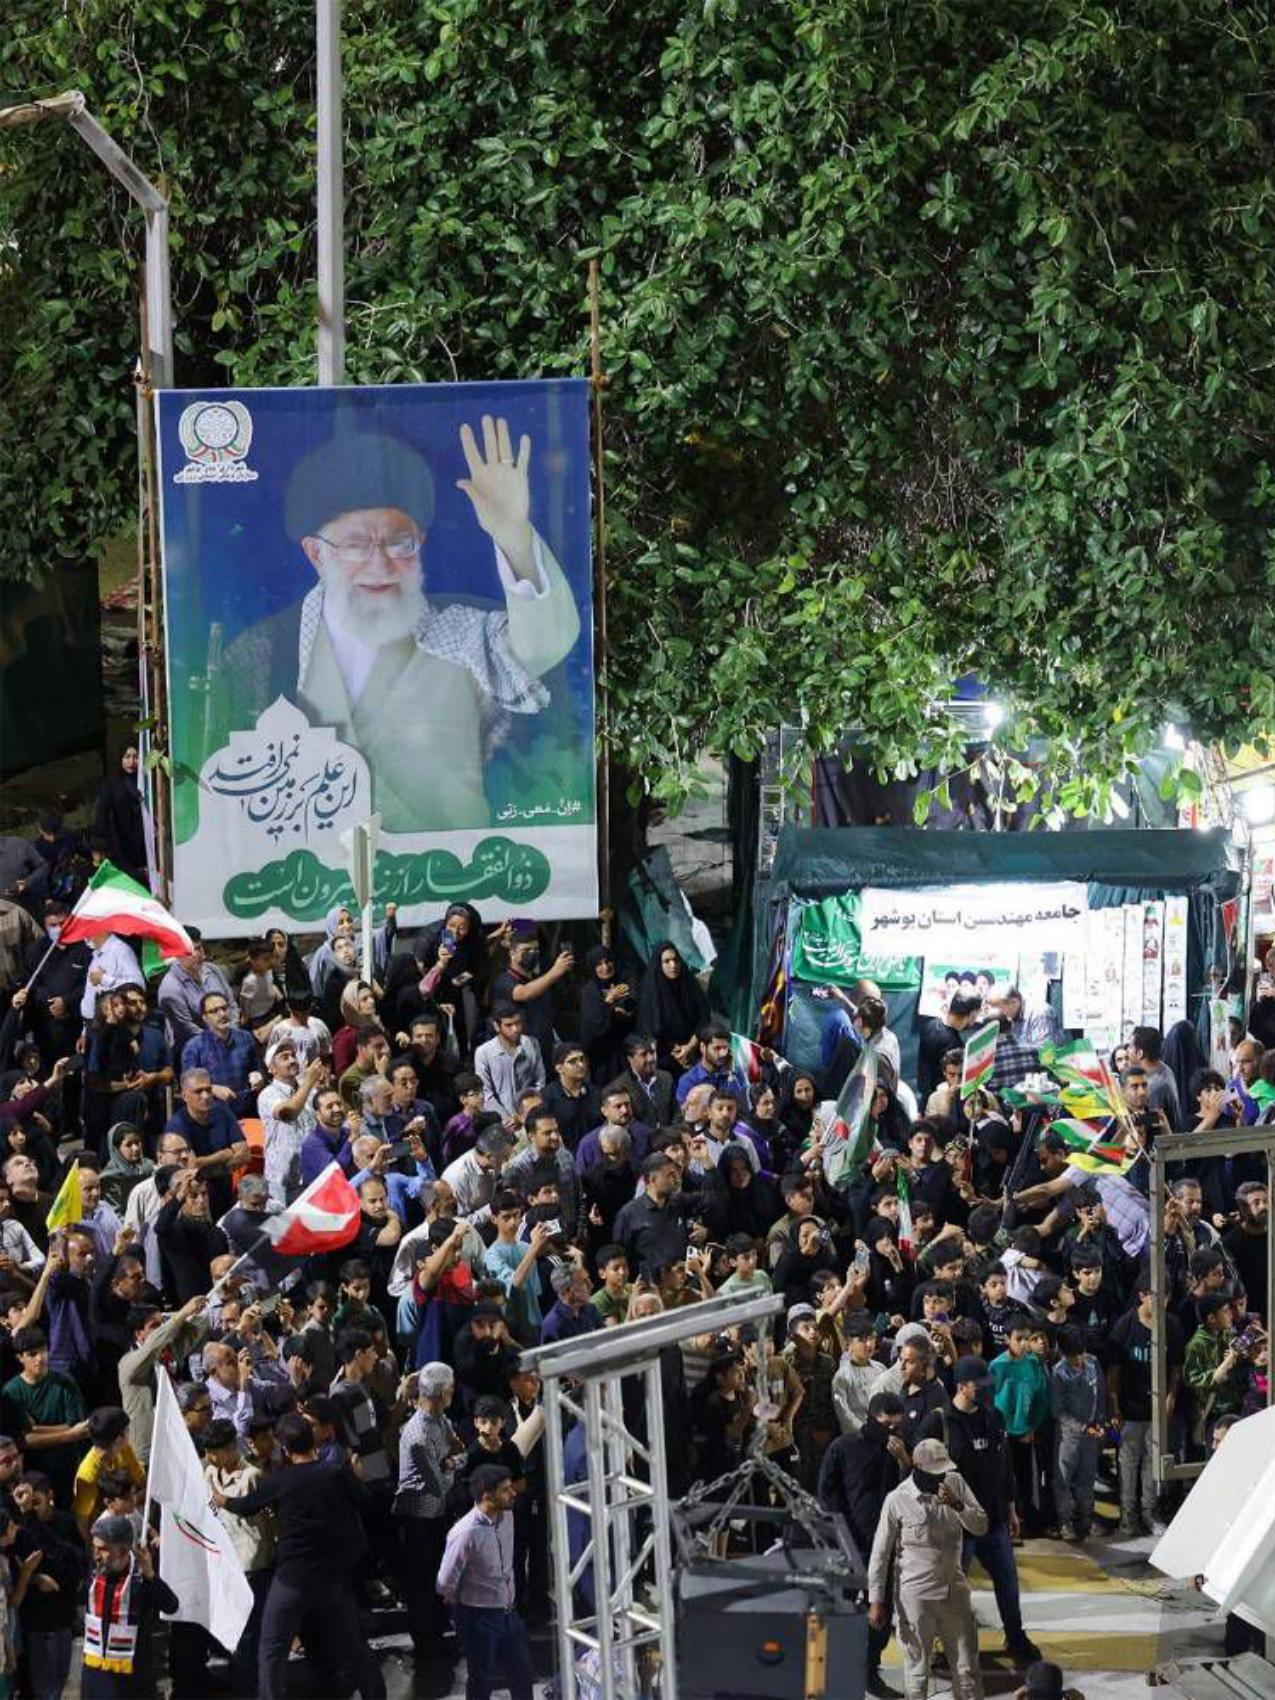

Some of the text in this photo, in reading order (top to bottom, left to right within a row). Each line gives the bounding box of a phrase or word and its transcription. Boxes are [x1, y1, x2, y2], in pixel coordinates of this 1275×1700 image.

[314, 766, 358, 830] این
[233, 856, 304, 906] است
[291, 874, 355, 908] یرون
[870, 908, 915, 931] بوشهر
[917, 909, 961, 930] استان
[1034, 904, 1081, 924] جامعه
